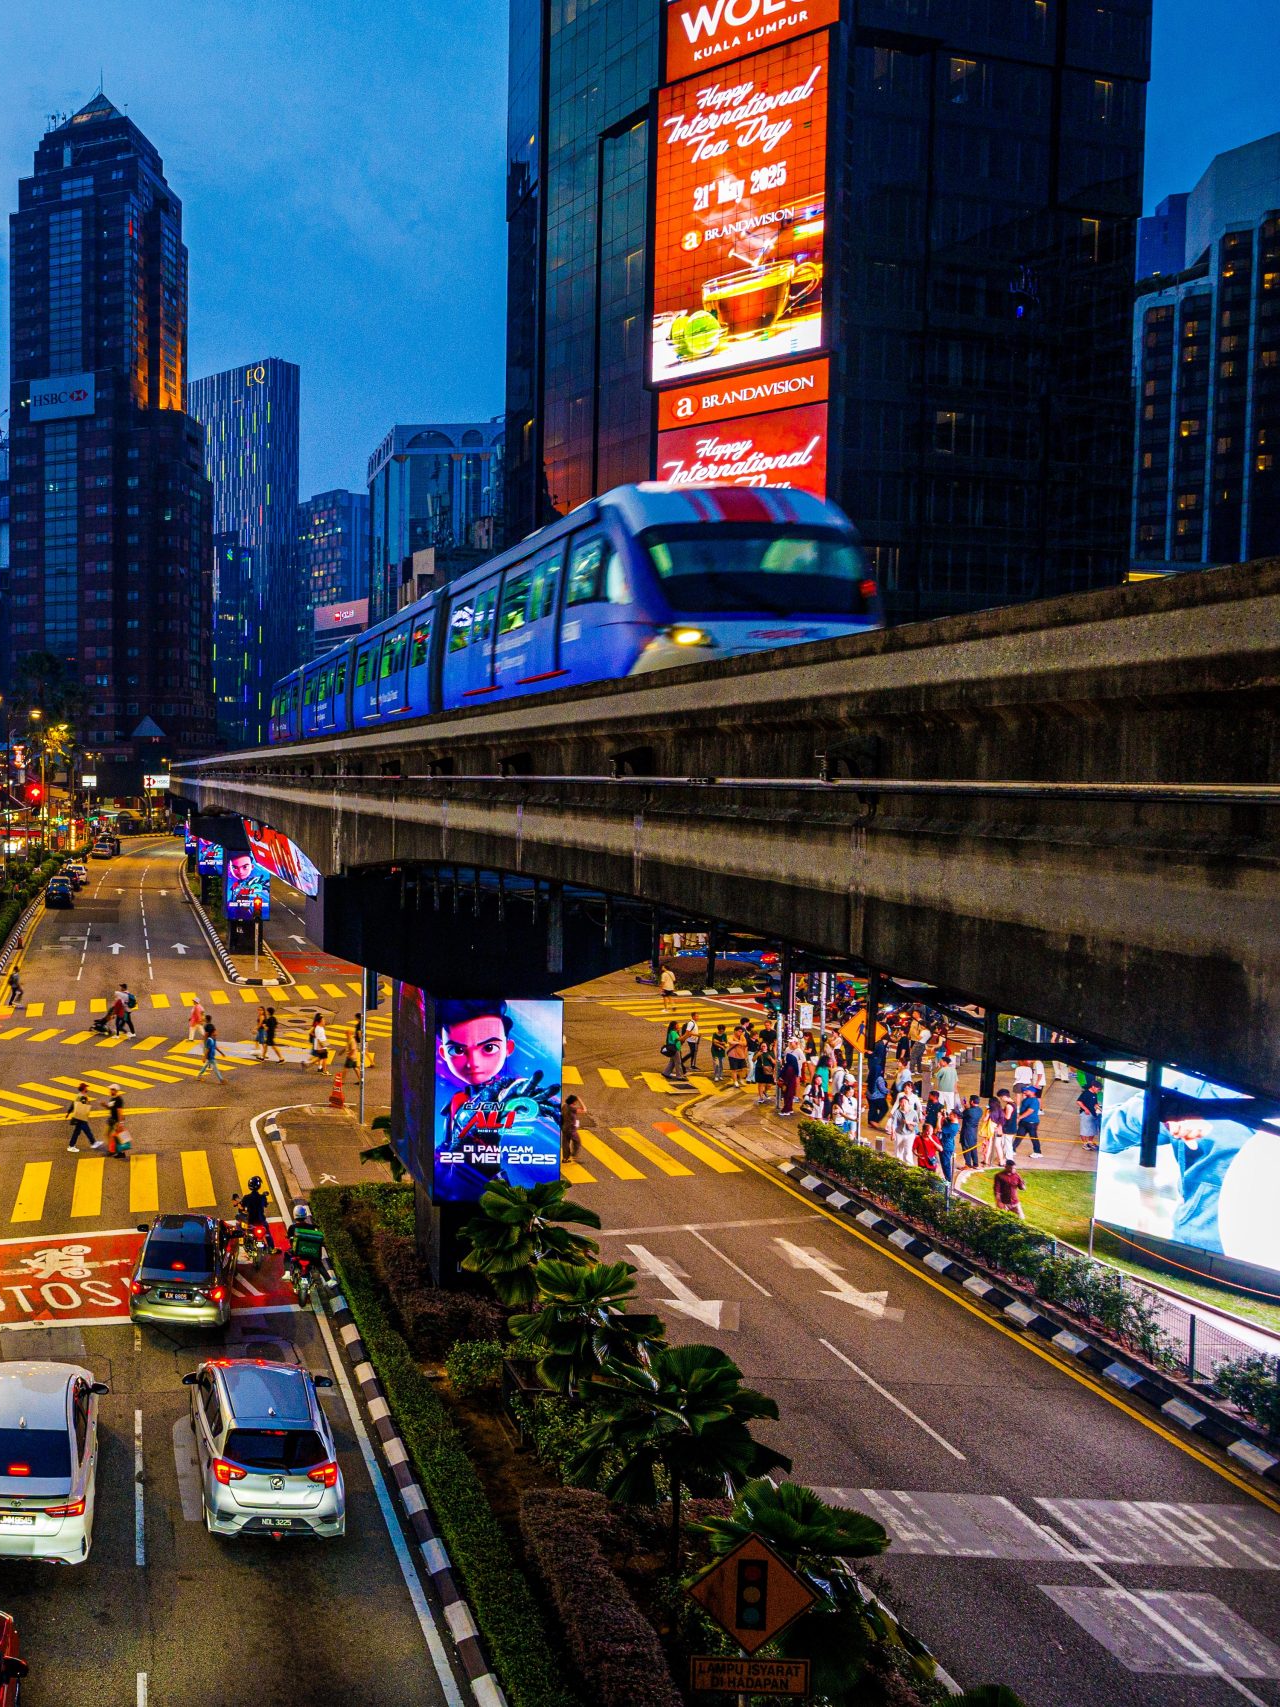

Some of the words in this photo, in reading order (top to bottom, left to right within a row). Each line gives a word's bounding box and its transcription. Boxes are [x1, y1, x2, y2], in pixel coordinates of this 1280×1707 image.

[681, 0, 808, 44] WOL
[694, 36, 741, 61] KUALA
[747, 10, 808, 41] LUMPUR
[663, 66, 822, 144] International
[696, 81, 754, 109] Happy
[686, 132, 731, 163] Tea
[735, 115, 793, 153] Day
[717, 178, 745, 204] May
[750, 161, 787, 195] 2025
[704, 207, 795, 242] BRANDAVISION
[246, 366, 265, 387] EQ
[33, 391, 68, 407] HSBC
[701, 375, 815, 409] BRANDAVISION
[662, 435, 821, 485] International
[695, 437, 753, 461] Happy
[458, 1110, 517, 1138] ALI
[439, 1152, 465, 1164] 22
[471, 1153, 501, 1164] MEI
[507, 1153, 557, 1165] 2025
[463, 1145, 474, 1153] DI
[477, 1145, 534, 1154] PAWAGAM
[698, 1662, 744, 1676] LAMPU
[747, 1663, 802, 1678] ISYARAT
[710, 1677, 726, 1688] DI
[727, 1677, 790, 1691] HADAPAN
